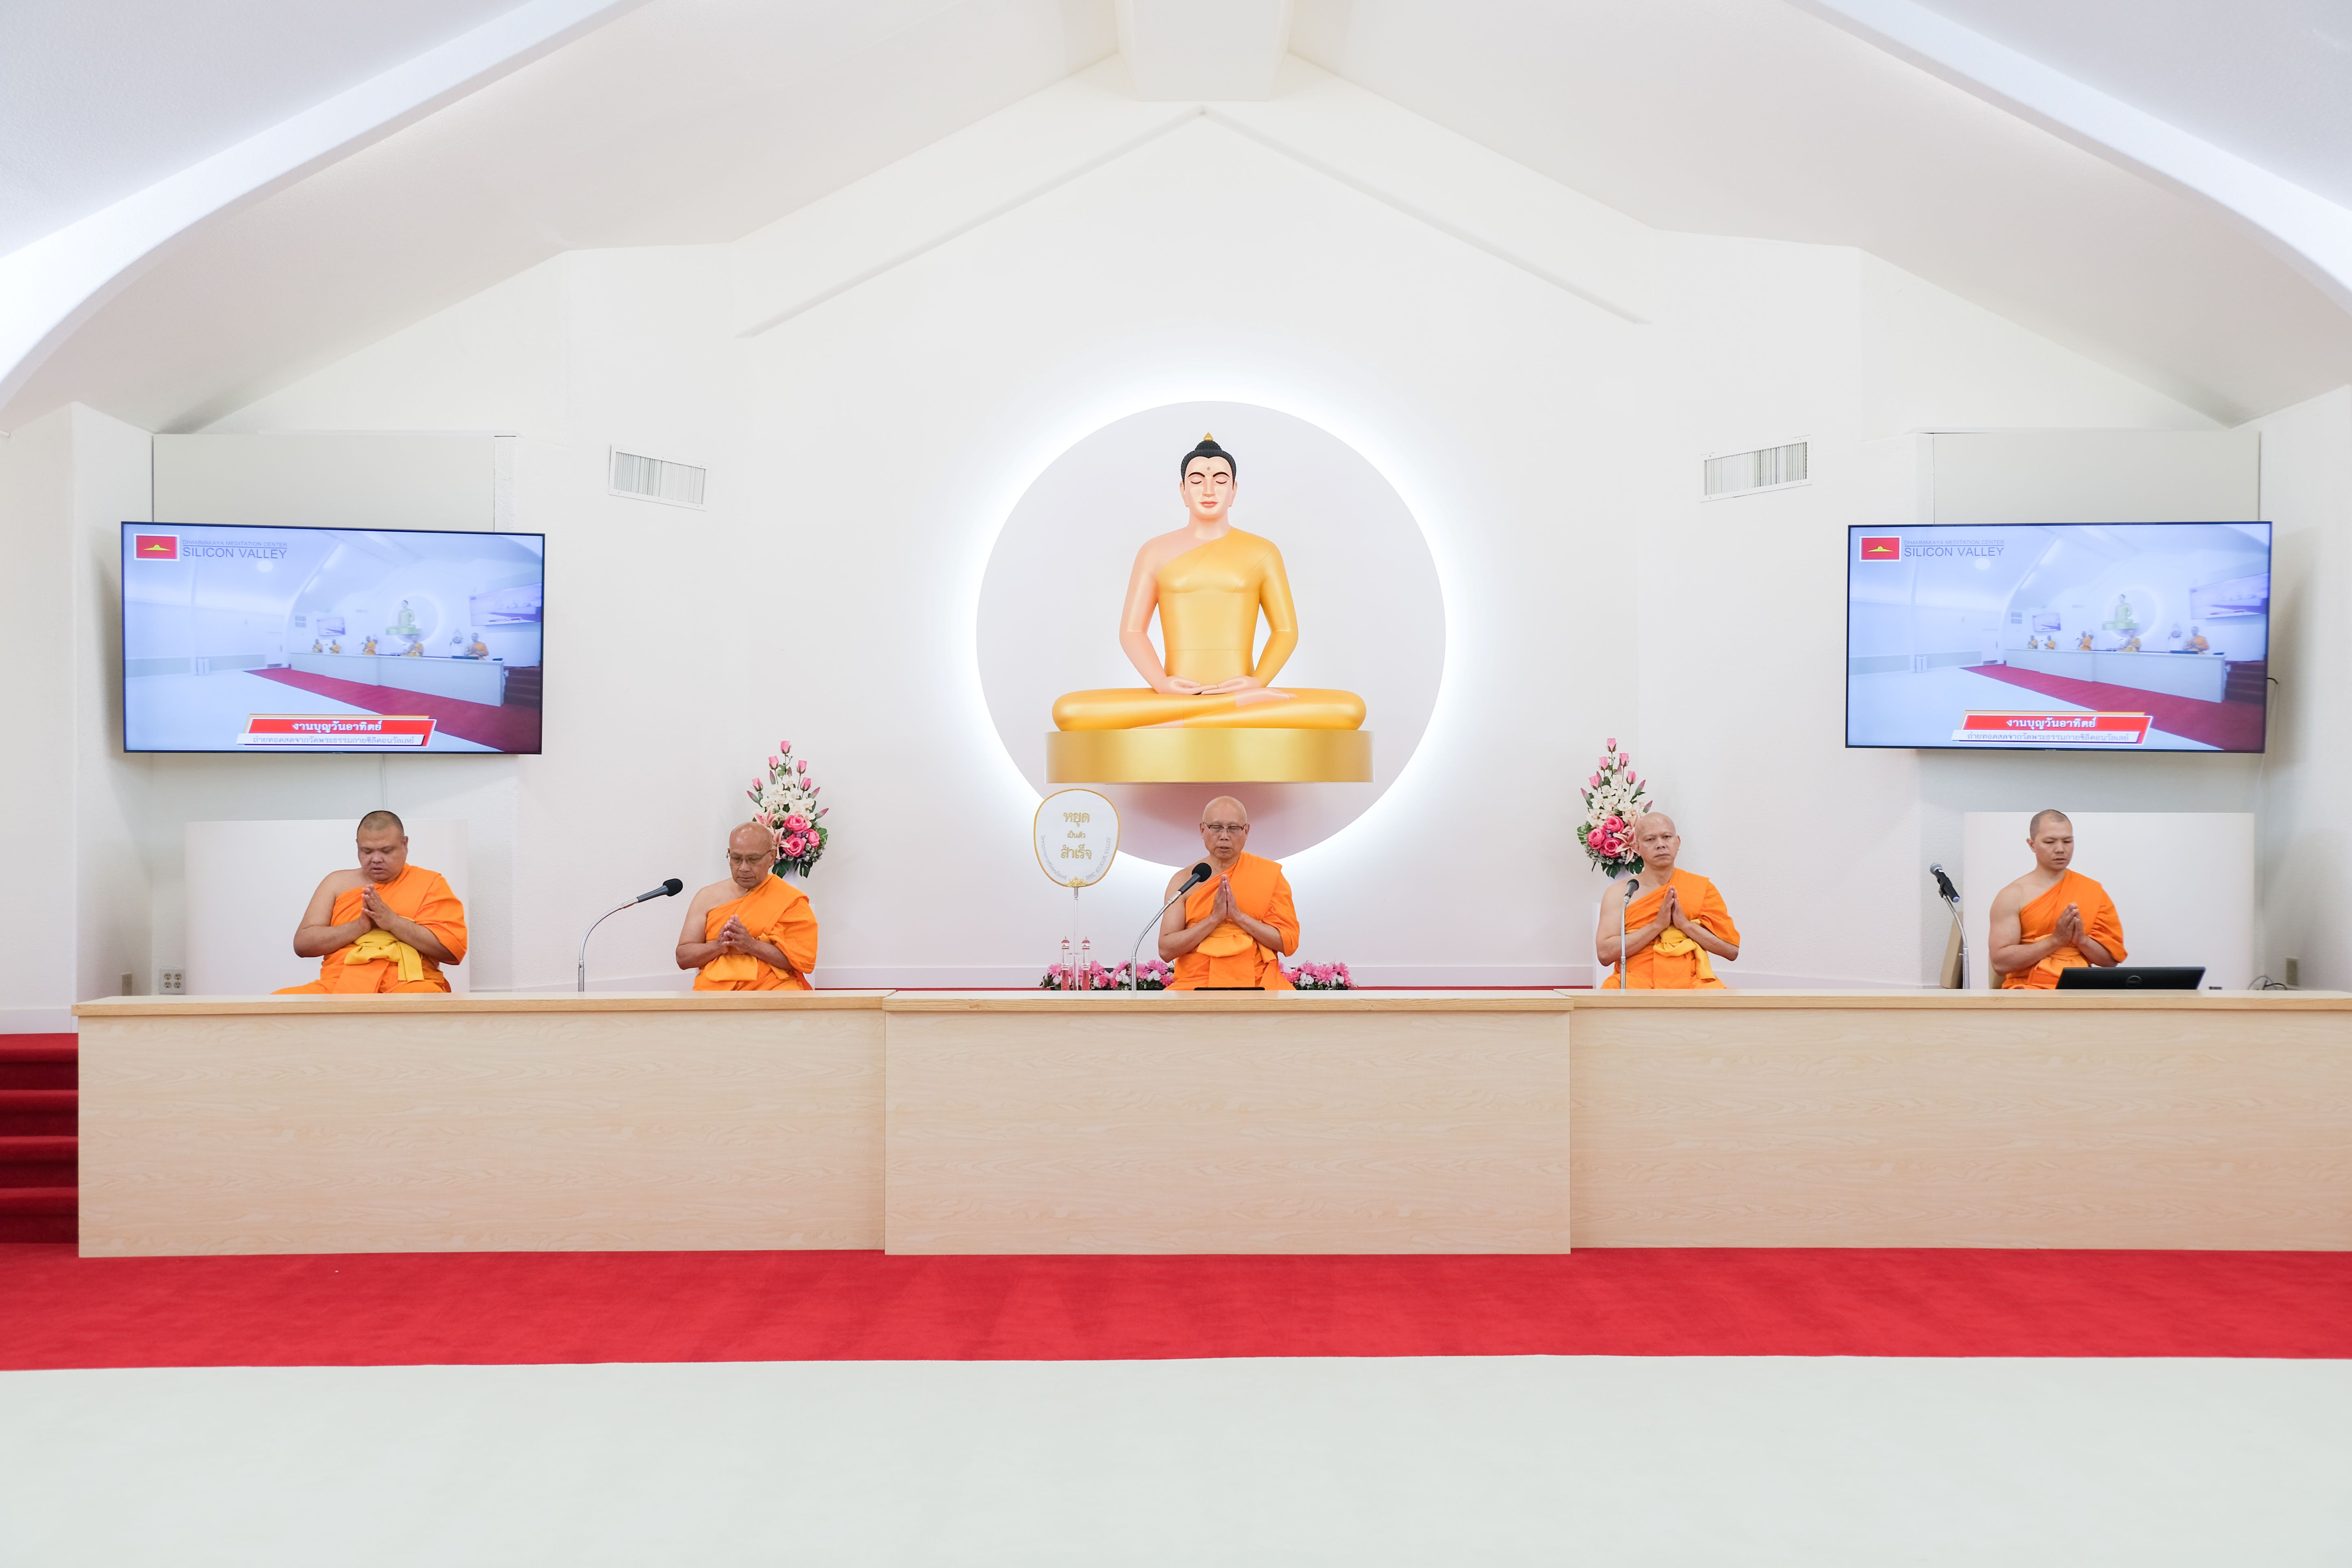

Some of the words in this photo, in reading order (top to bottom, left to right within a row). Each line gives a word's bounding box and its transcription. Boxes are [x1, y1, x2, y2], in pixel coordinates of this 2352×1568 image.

[183, 547, 234, 557] SILICON
[238, 549, 287, 559] VALLEY
[1904, 547, 1952, 557] SILICON
[1957, 547, 2004, 556] VALLEY
[292, 720, 383, 733] งานบุญวันอาทิตย์
[2006, 717, 2097, 730] งานบุญวันอาทิตย์
[1063, 812, 1090, 827] หยุด
[1067, 830, 1086, 839] เป็นตัว
[1061, 844, 1092, 859] สำเร็จ
[1095, 855, 1107, 873] SILICON
